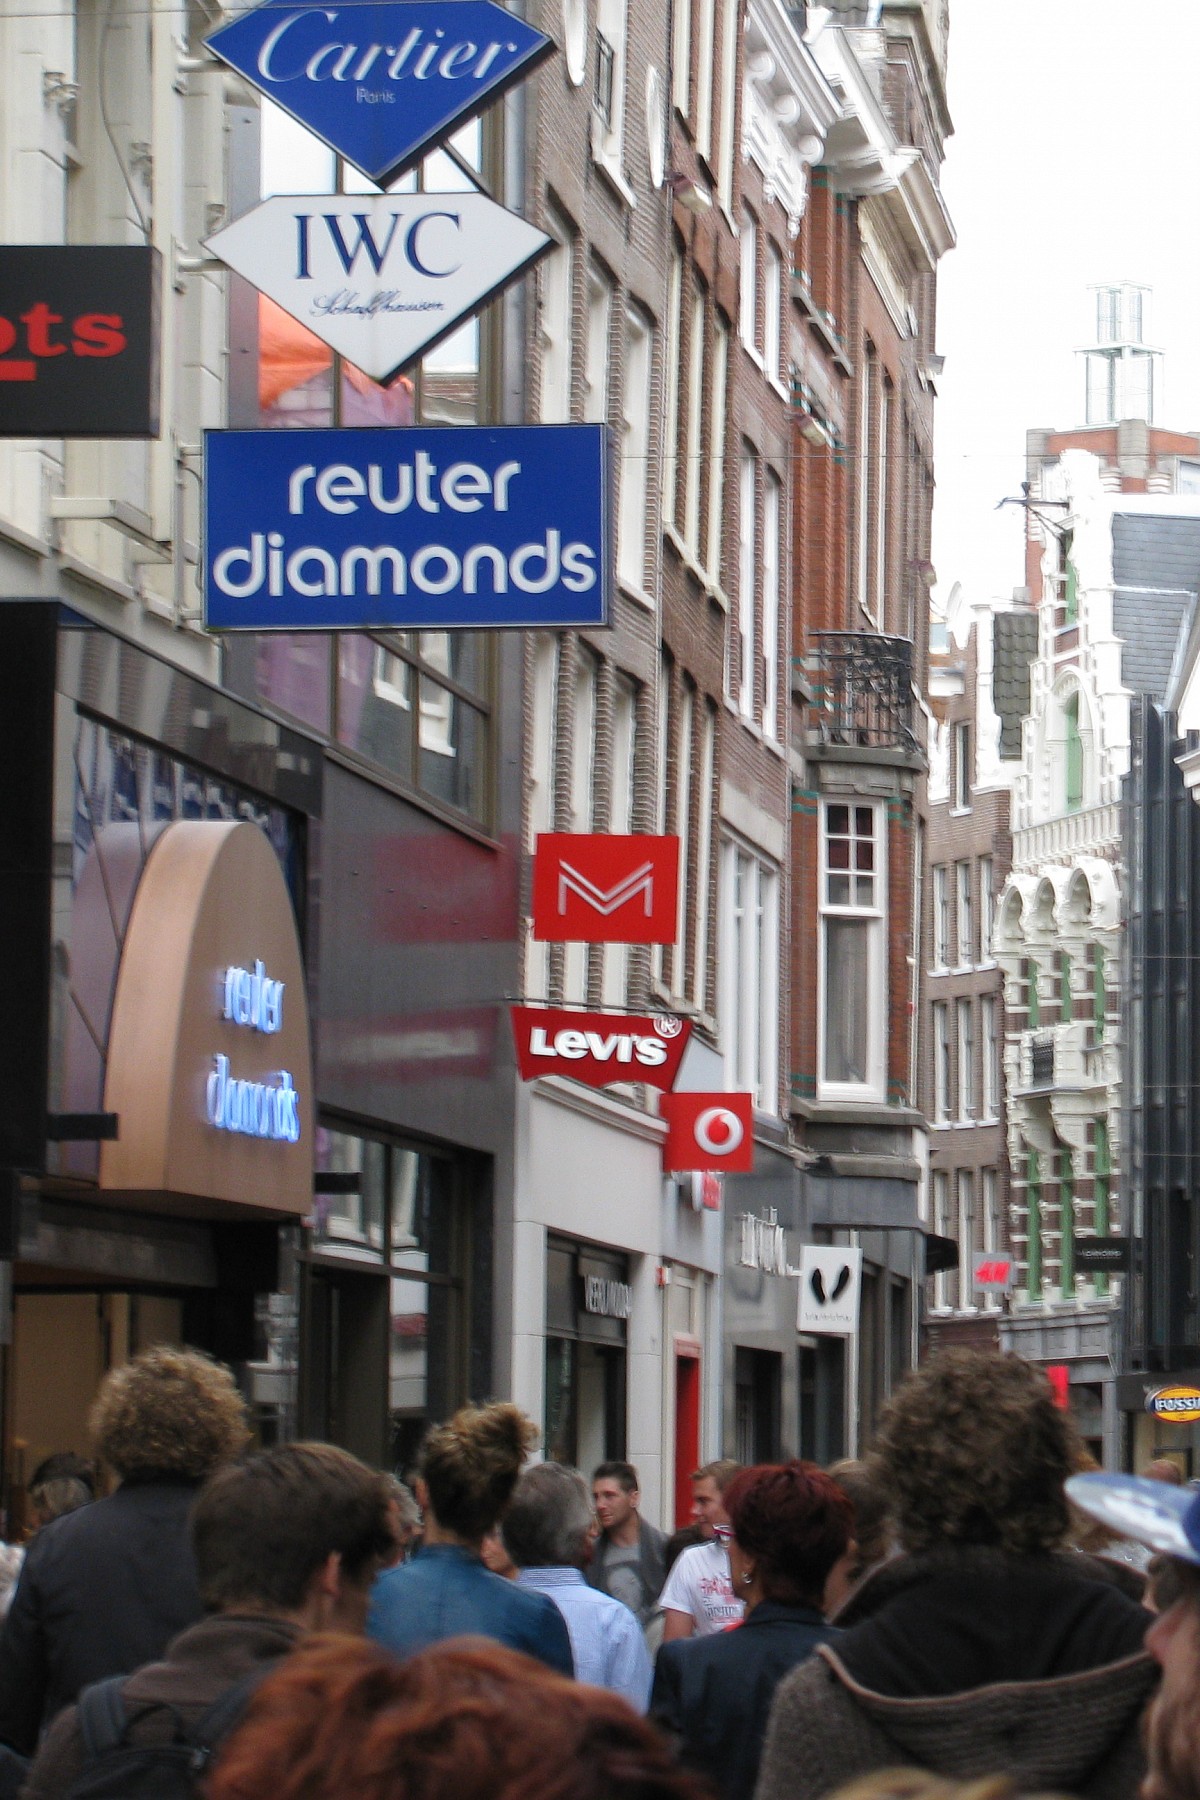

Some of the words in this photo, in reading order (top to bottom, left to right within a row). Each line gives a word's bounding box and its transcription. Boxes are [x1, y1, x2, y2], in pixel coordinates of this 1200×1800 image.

[257, 9, 518, 83] Cartier
[294, 212, 463, 280] IWC
[288, 450, 521, 515] reuter
[212, 528, 597, 598] diamonds
